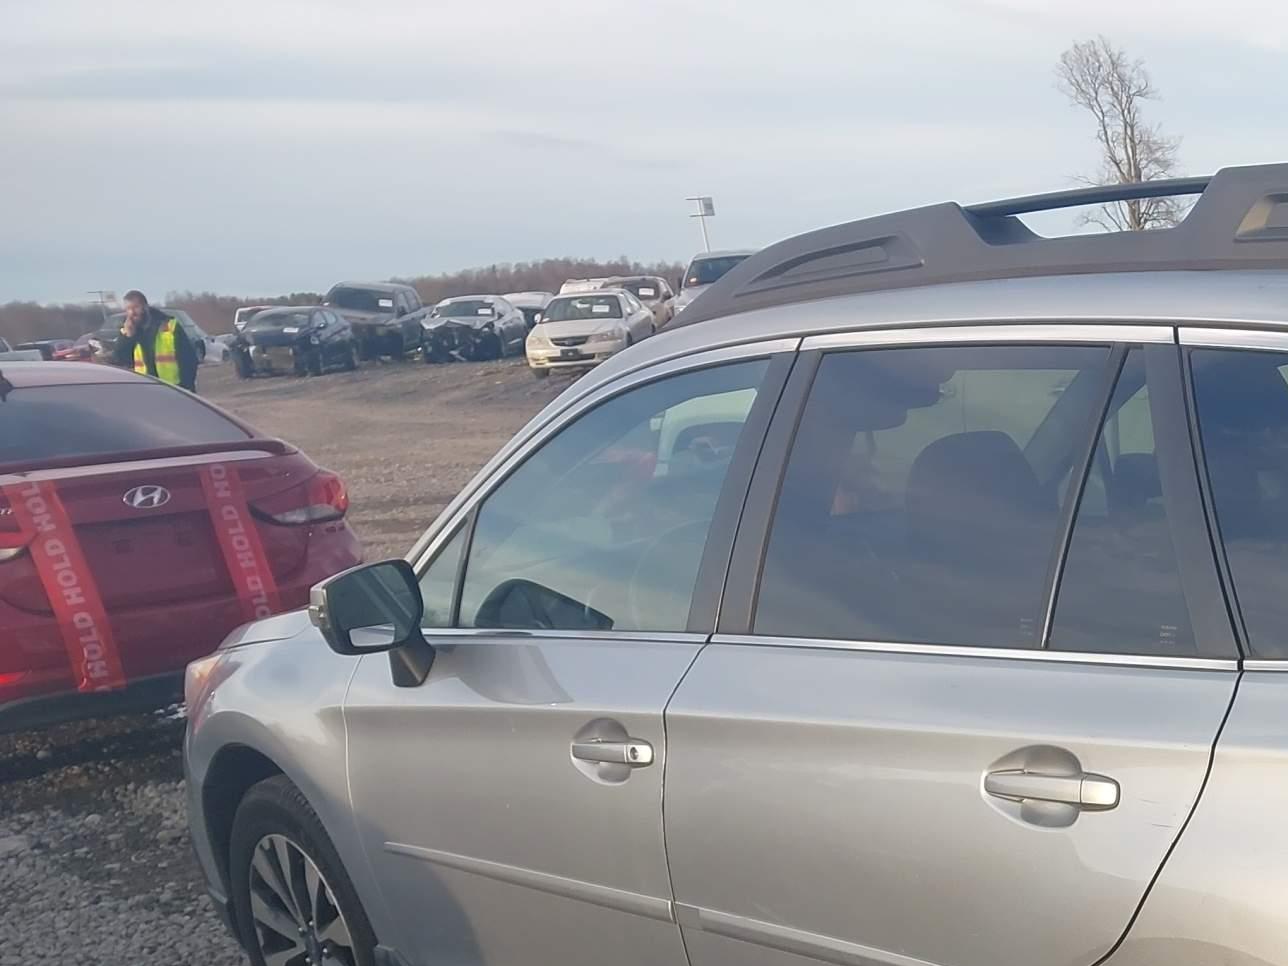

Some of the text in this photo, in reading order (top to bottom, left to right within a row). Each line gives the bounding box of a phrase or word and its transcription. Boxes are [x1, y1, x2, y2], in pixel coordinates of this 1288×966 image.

[22, 482, 56, 532] HOL
[210, 464, 231, 497] HO
[222, 505, 256, 568] HOLD
[44, 539, 86, 605] HOLD
[245, 575, 271, 618] OLD
[73, 612, 108, 679] HOLD
